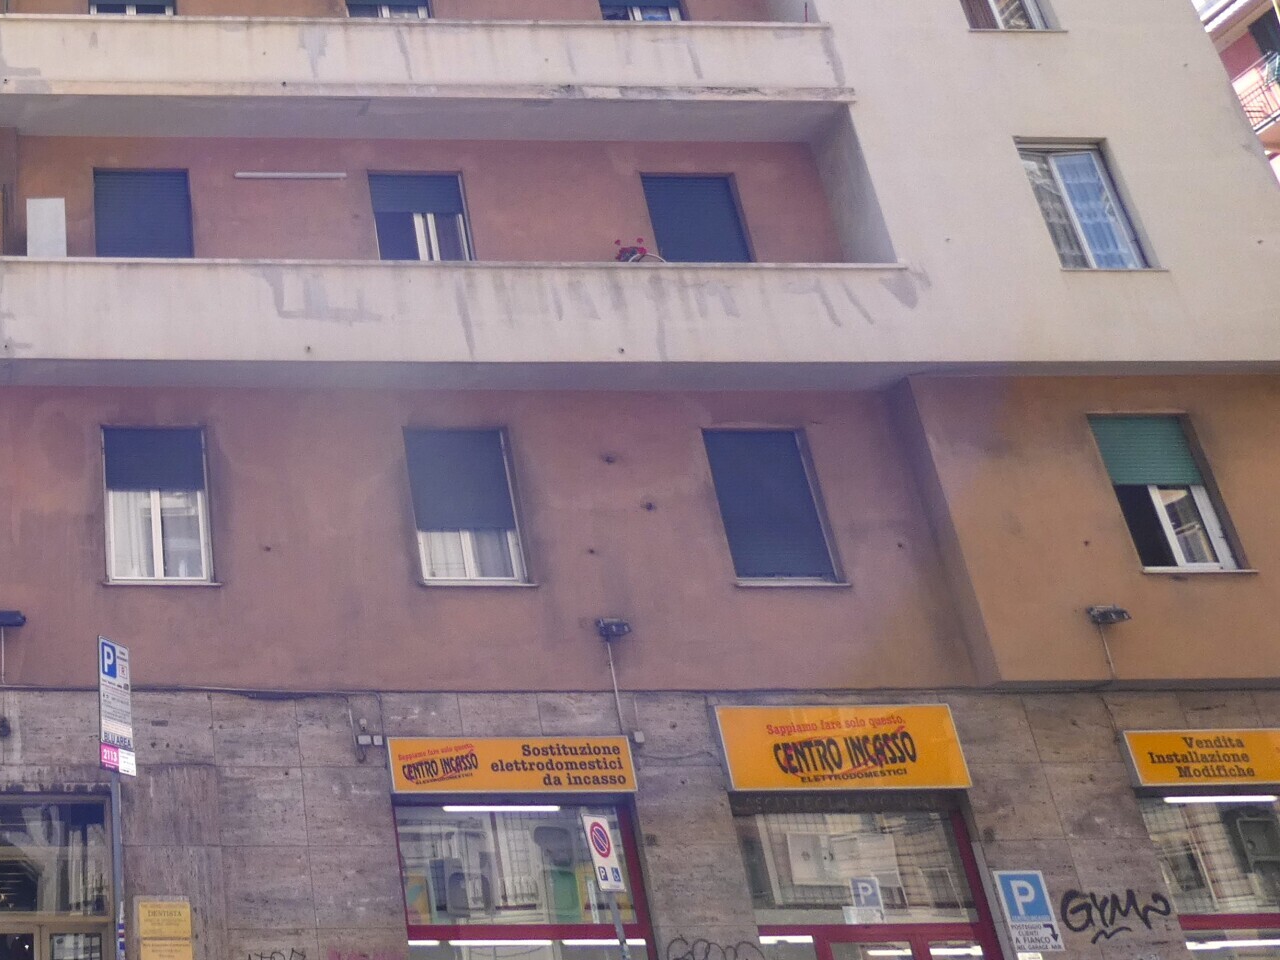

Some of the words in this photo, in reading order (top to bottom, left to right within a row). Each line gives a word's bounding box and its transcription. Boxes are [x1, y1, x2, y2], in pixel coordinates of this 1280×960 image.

[104, 644, 114, 673] P
[766, 722, 818, 736] Sappiamo
[820, 719, 842, 730] fare
[845, 717, 866, 728] solo
[1182, 736, 1245, 748] Vendita
[103, 748, 118, 762] 2113
[521, 743, 620, 756] Sostituzione
[773, 737, 843, 774] CENTRO
[843, 730, 918, 769] INCASSO
[491, 757, 624, 771] elettrodomestici
[1148, 750, 1250, 764] Installazione
[402, 759, 439, 781] CENTRO
[439, 753, 478, 774] INCASSO
[1176, 765, 1255, 778] Modifiche
[543, 774, 562, 785] da
[567, 773, 626, 785] incasso
[801, 768, 907, 783] ELETTRODOMESTICI
[600, 869, 606, 880] P
[857, 882, 873, 906] P
[1009, 880, 1036, 916] P
[147, 909, 182, 917] DENTISTA
[1023, 936, 1051, 944] FIANCO
